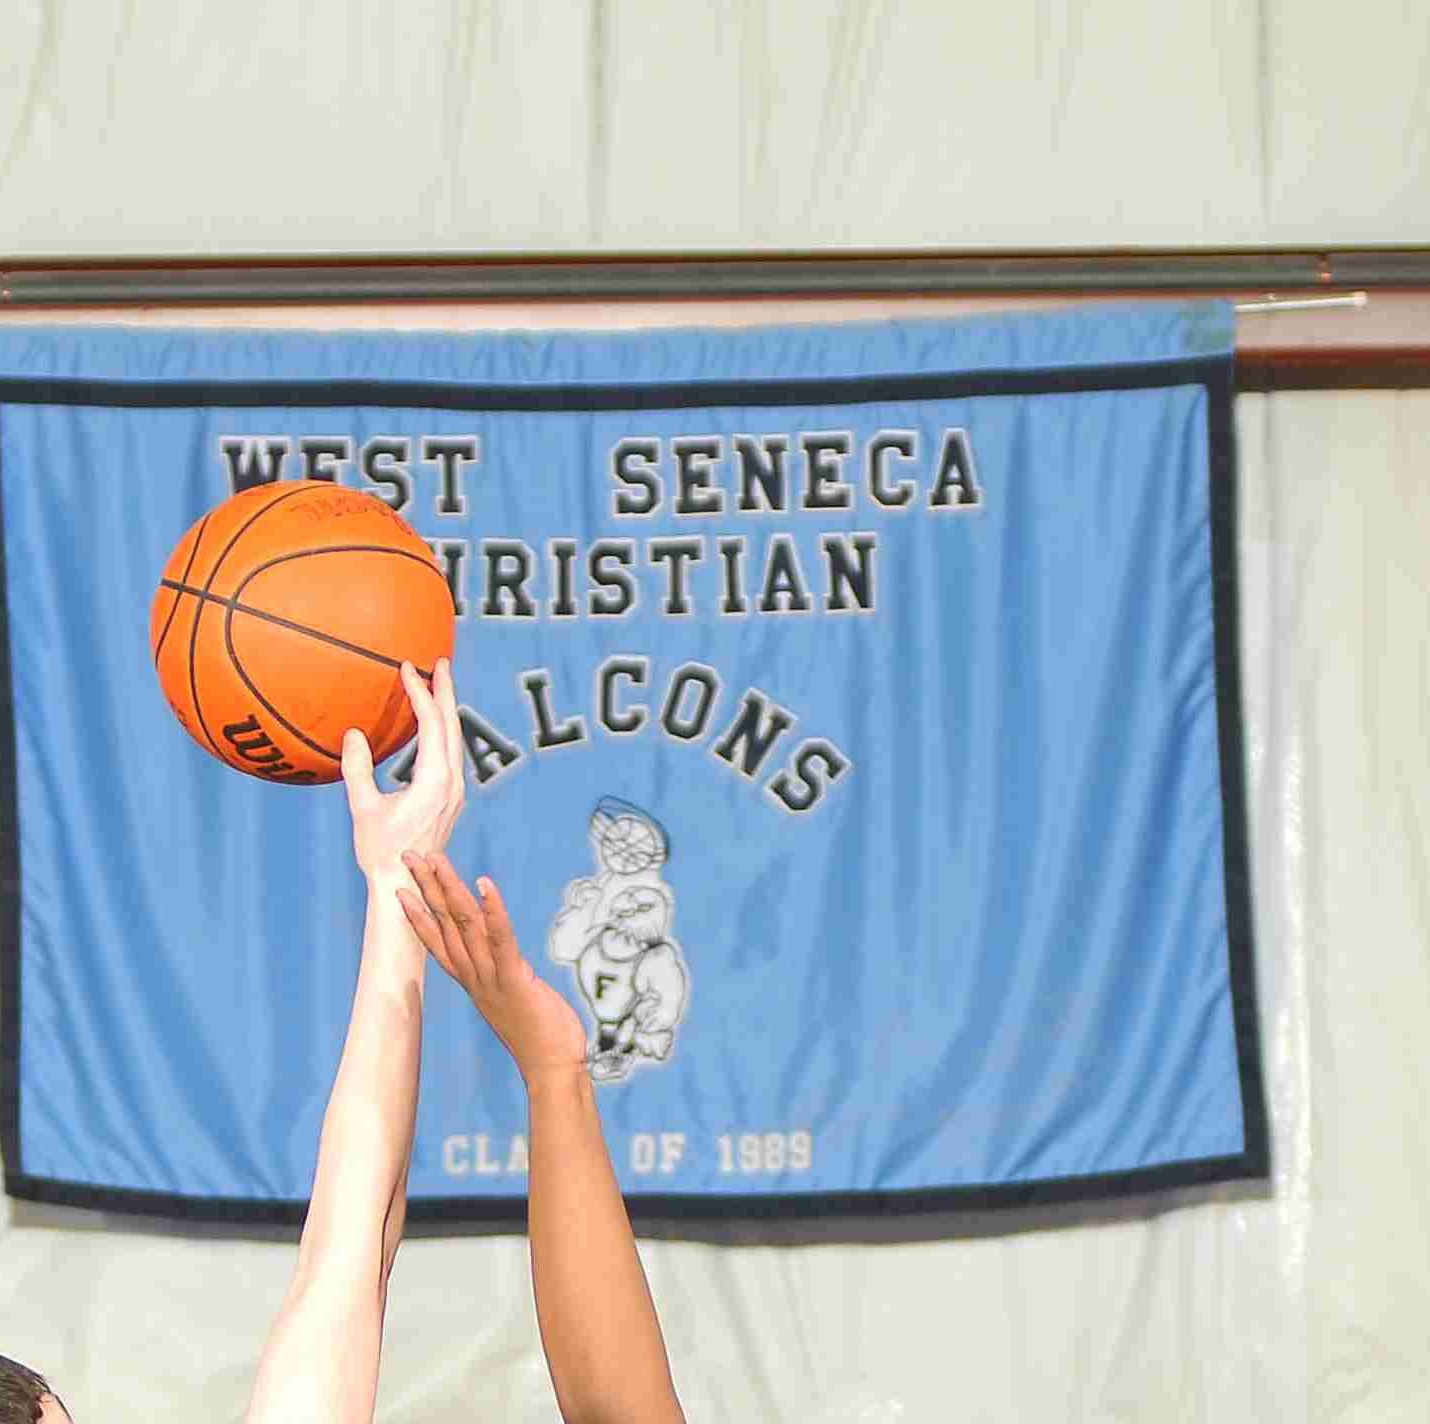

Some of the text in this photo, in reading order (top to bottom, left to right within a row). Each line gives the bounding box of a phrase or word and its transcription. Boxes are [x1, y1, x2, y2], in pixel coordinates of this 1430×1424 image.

[218, 434, 480, 517] WEST
[611, 427, 983, 518] SENECA
[424, 531, 876, 619] RISTIAN
[388, 655, 853, 813] ALCONS
[595, 974, 617, 999] F
[442, 1129, 813, 1175] CLA OF 1989
